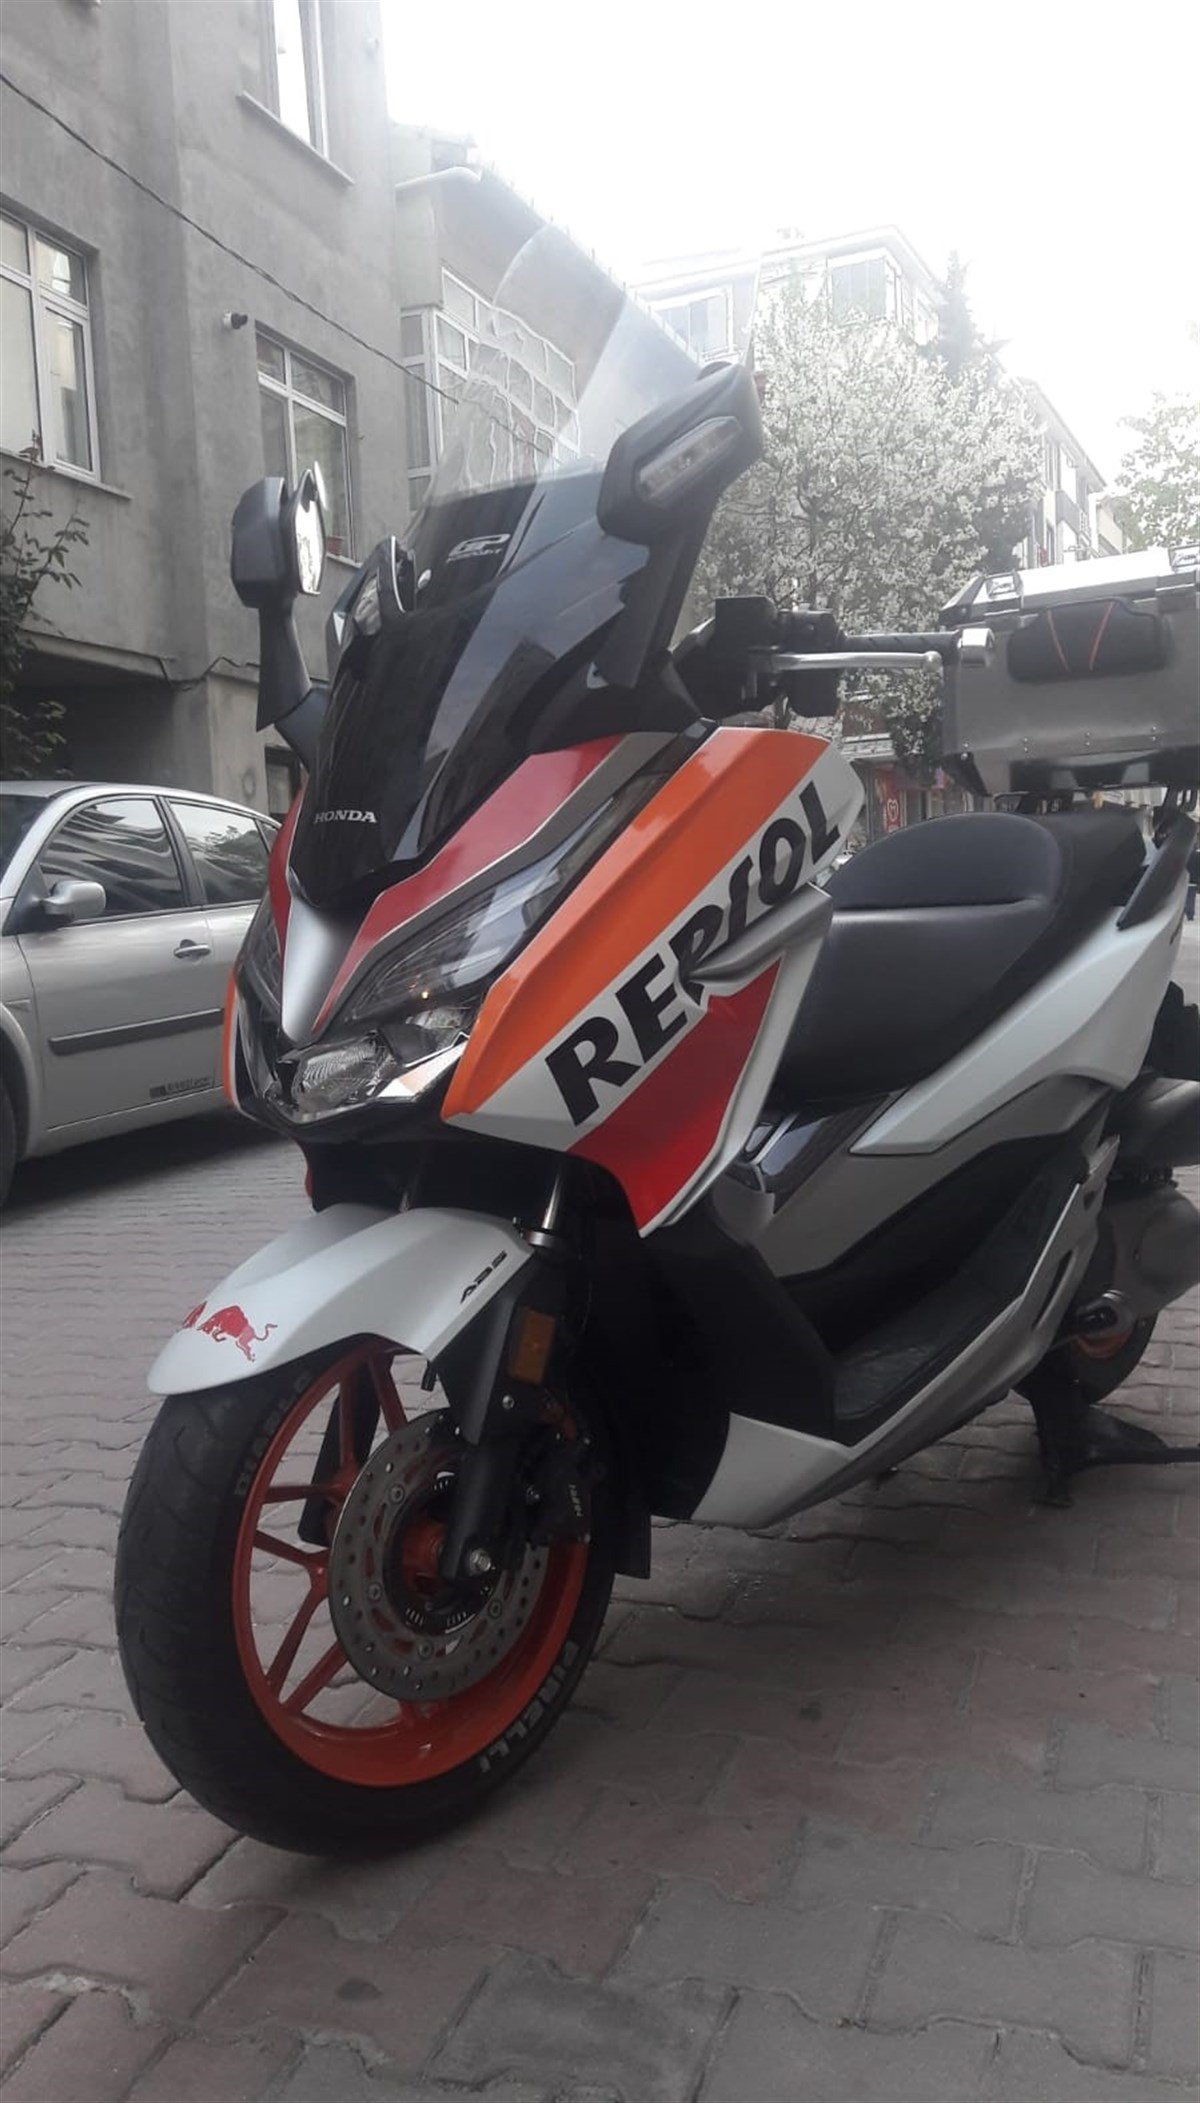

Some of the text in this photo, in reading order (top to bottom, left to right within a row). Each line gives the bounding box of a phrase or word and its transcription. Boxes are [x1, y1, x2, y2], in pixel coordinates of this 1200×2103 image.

[313, 809, 377, 824] HONDA
[544, 780, 841, 1127] REPSOL
[460, 1249, 508, 1304] ABS
[479, 1640, 581, 1774] PIRELLI
